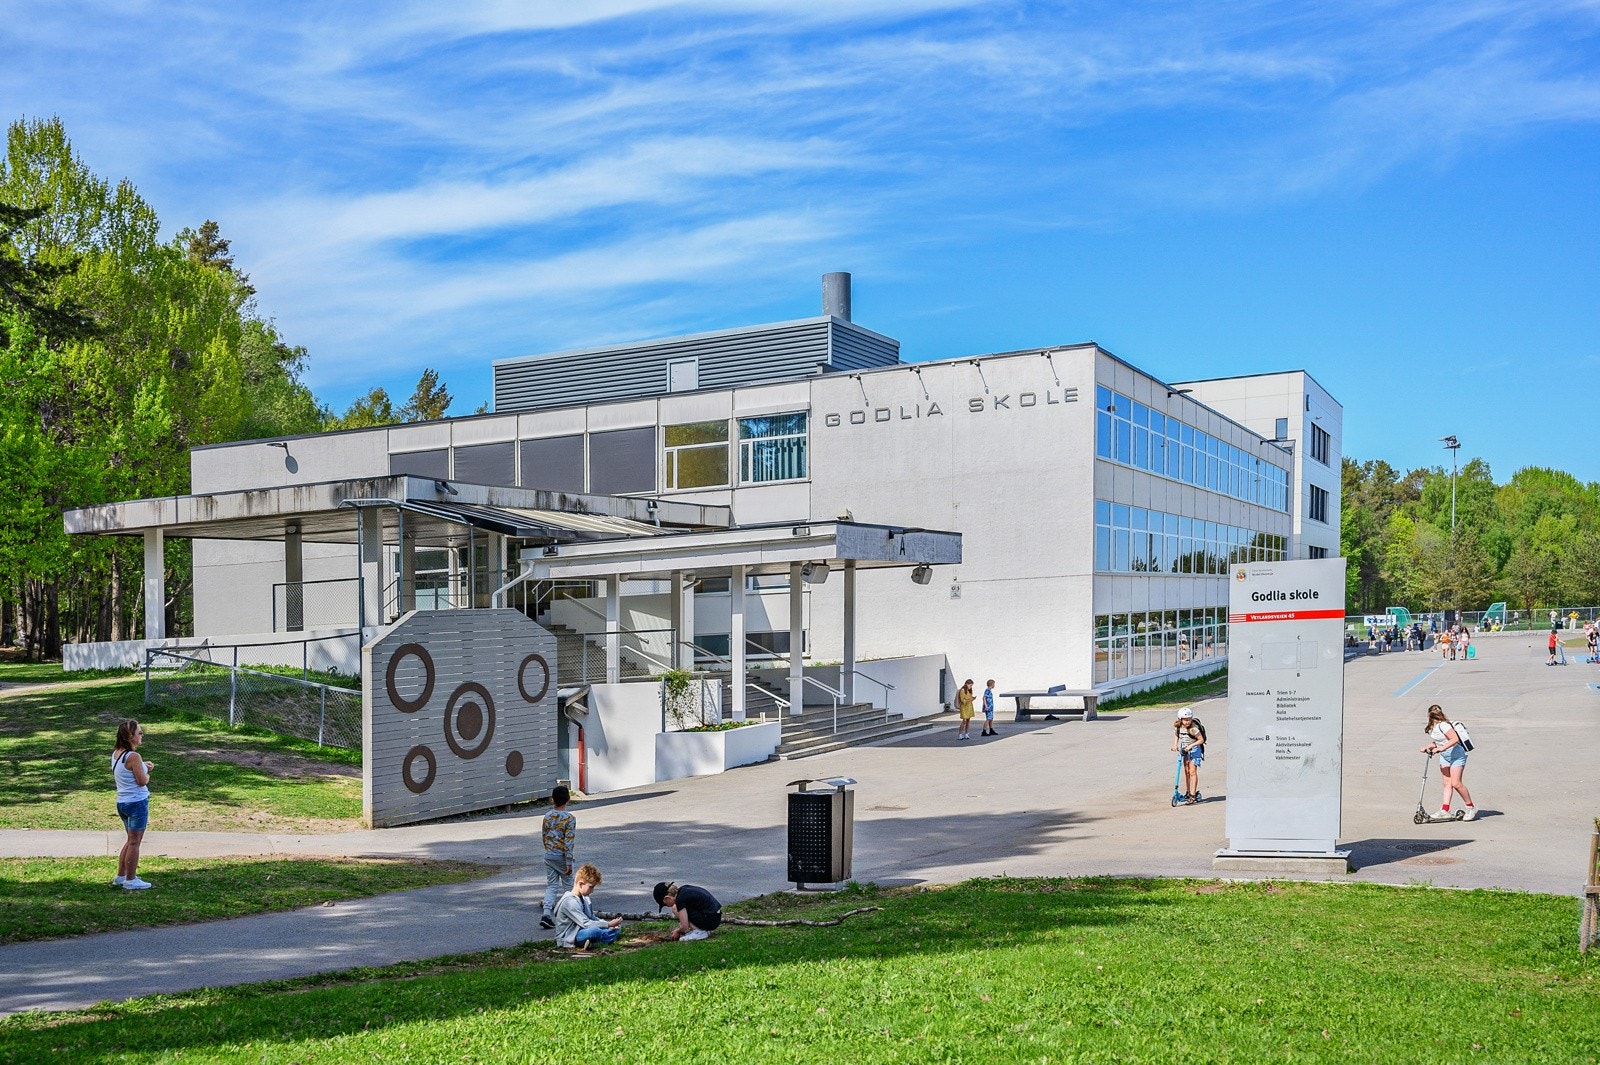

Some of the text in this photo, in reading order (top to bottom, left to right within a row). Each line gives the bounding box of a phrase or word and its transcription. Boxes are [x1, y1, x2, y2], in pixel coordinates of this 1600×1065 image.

[825, 387, 1079, 427] GODLIA SKOLE
[899, 536, 906, 556] A
[1251, 588, 1319, 602] Godlia skole
